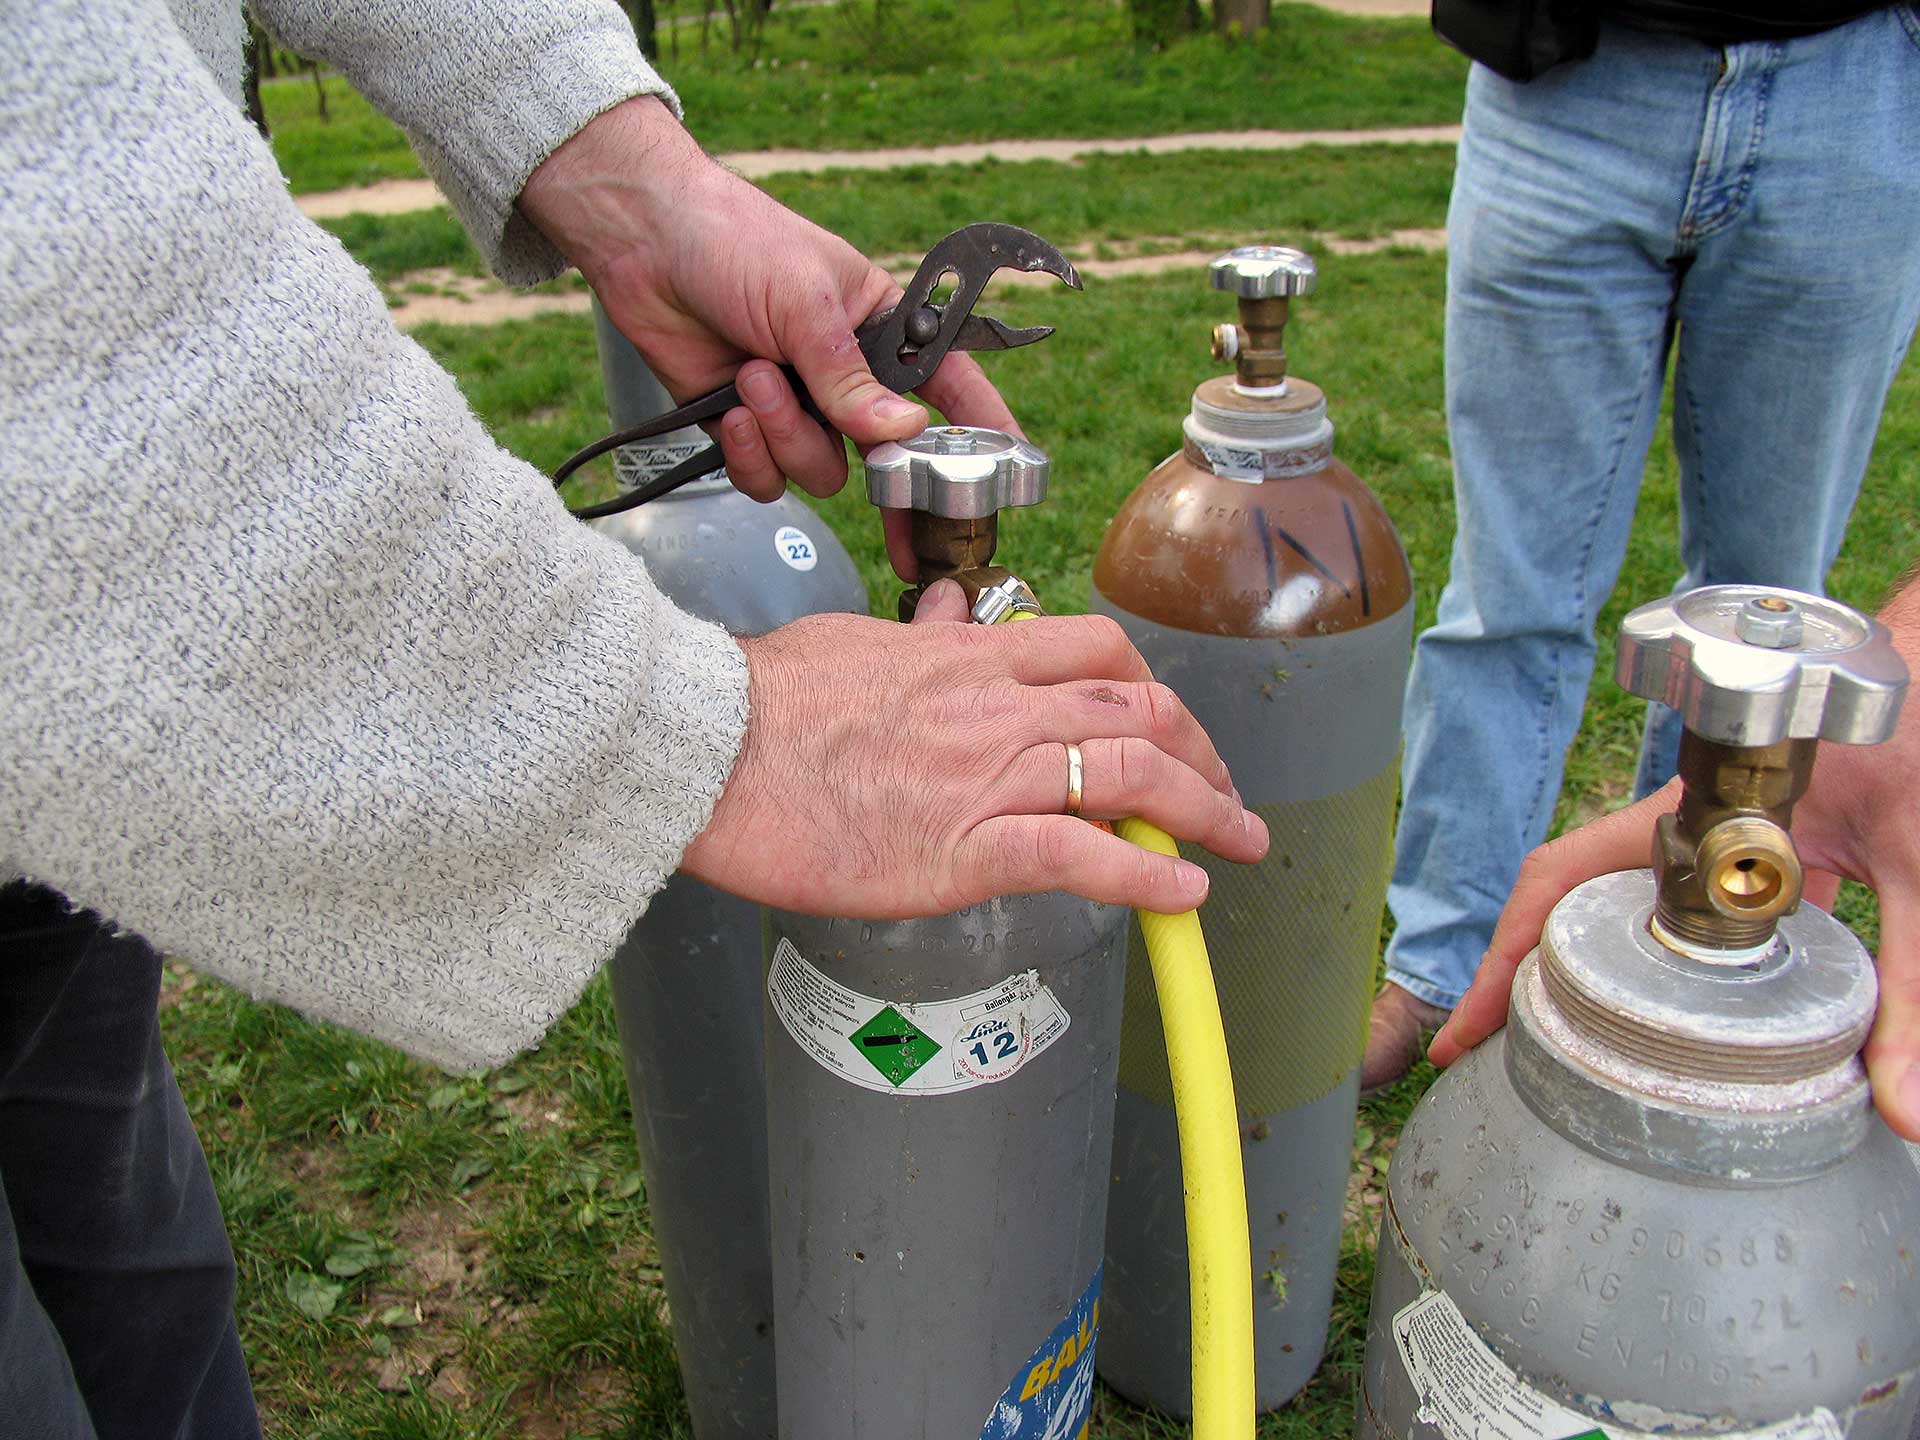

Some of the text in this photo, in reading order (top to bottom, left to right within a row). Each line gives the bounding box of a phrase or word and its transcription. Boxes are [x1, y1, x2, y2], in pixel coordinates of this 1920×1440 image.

[787, 543, 812, 559] 22
[984, 992, 1018, 1012] Ballongáz
[969, 1031, 1019, 1066] 12
